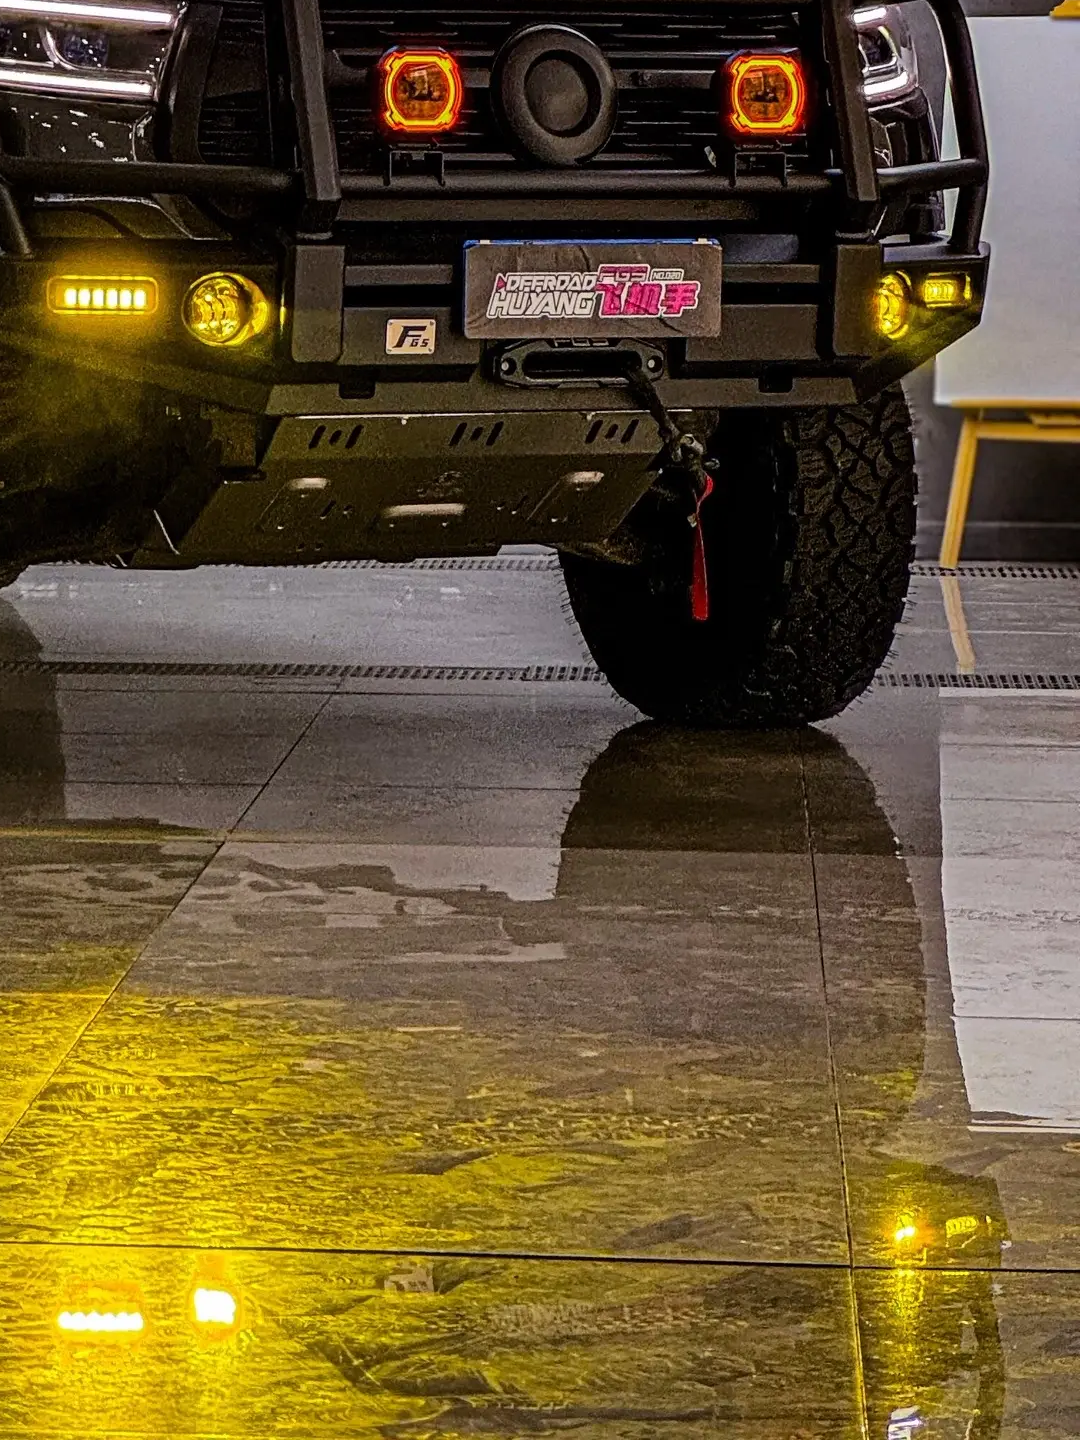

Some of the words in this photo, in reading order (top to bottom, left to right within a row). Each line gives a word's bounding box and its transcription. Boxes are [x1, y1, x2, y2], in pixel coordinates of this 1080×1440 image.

[489, 292, 595, 316] HUYANG
[595, 282, 698, 315] 飞机手
[392, 325, 430, 348] FGS
